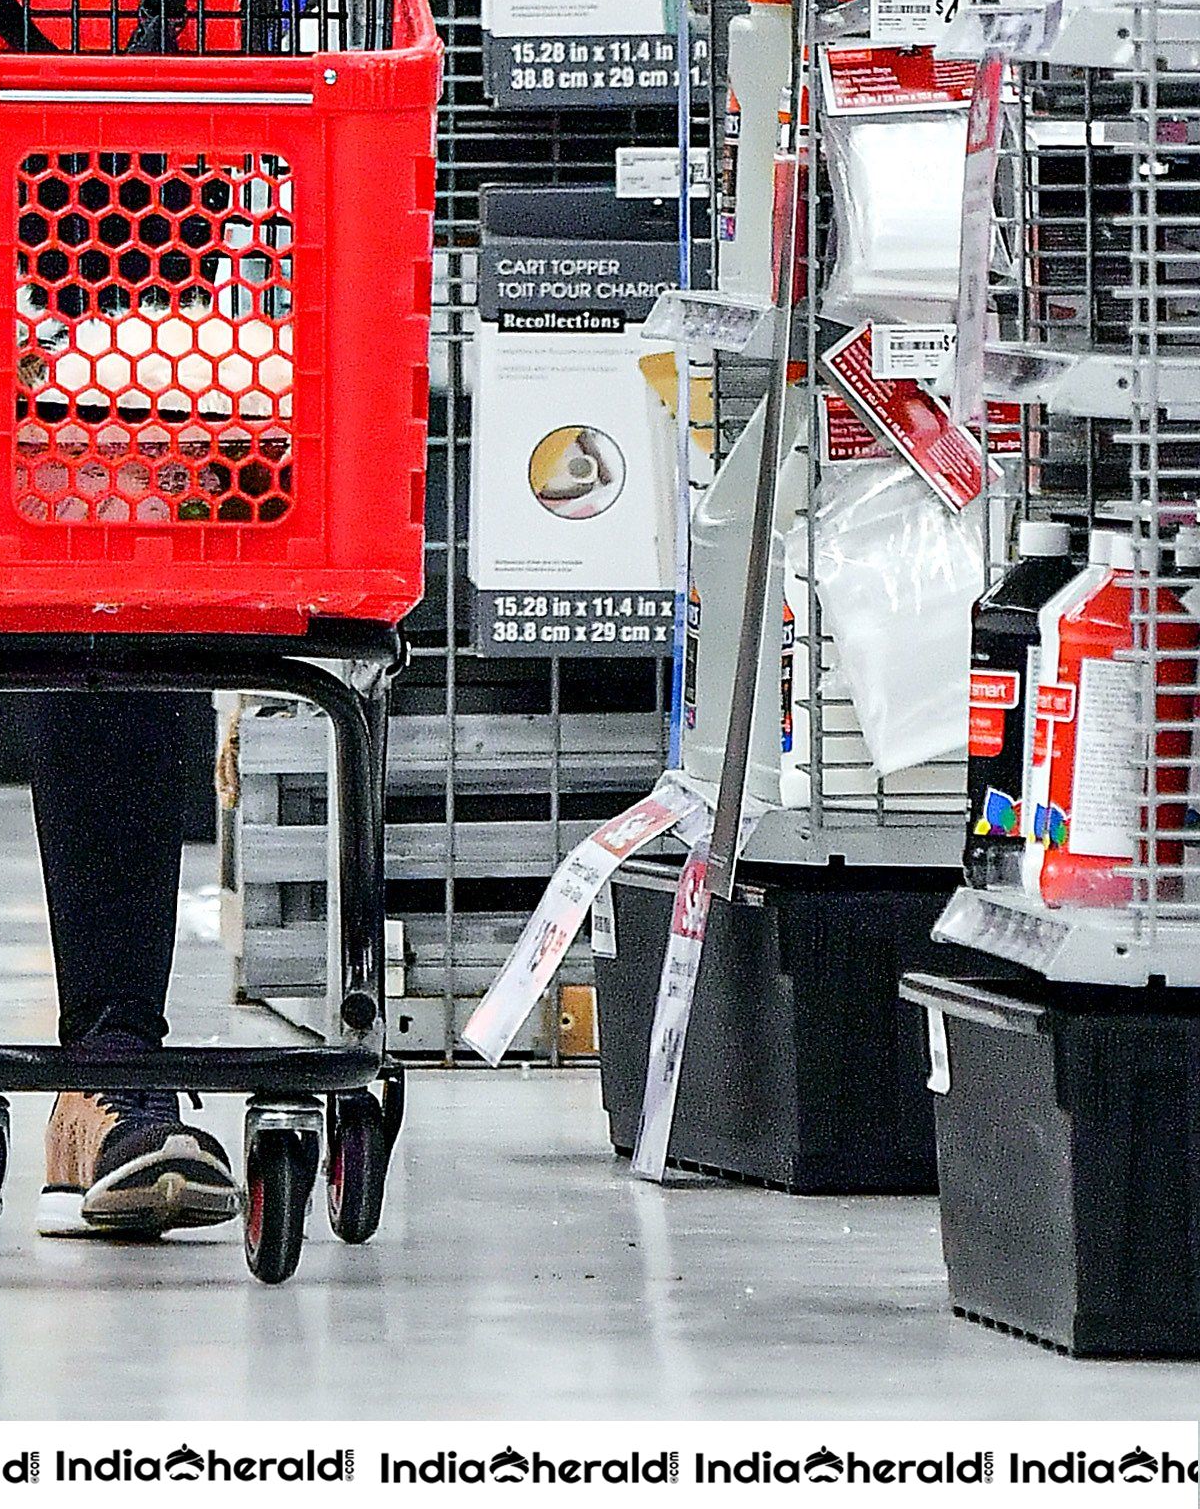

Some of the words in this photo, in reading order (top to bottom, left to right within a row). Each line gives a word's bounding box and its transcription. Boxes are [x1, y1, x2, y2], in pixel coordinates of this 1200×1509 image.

[511, 41, 565, 64] 15.28
[569, 42, 588, 63] in
[593, 45, 605, 63] x
[609, 41, 651, 62] 11.4
[655, 41, 674, 62] in
[511, 67, 555, 90] 38.8
[558, 71, 589, 89] cm
[593, 71, 605, 89] x
[608, 66, 634, 88] 29
[638, 69, 668, 88] cm
[498, 259, 548, 276] CART
[551, 259, 620, 276] TOPPER
[498, 282, 539, 299] TOIT
[541, 282, 591, 299] POUR
[502, 311, 620, 329] Recollections
[493, 596, 548, 617] 15.28
[552, 597, 571, 617] in
[575, 600, 588, 617] x
[592, 597, 633, 617] 11.4
[637, 596, 656, 617] in
[660, 600, 673, 617] x
[492, 621, 537, 642] 38.8
[541, 625, 571, 642] cm
[574, 625, 588, 642] x
[590, 621, 616, 642] 29
[621, 625, 650, 642] cm
[654, 625, 667, 642] x
